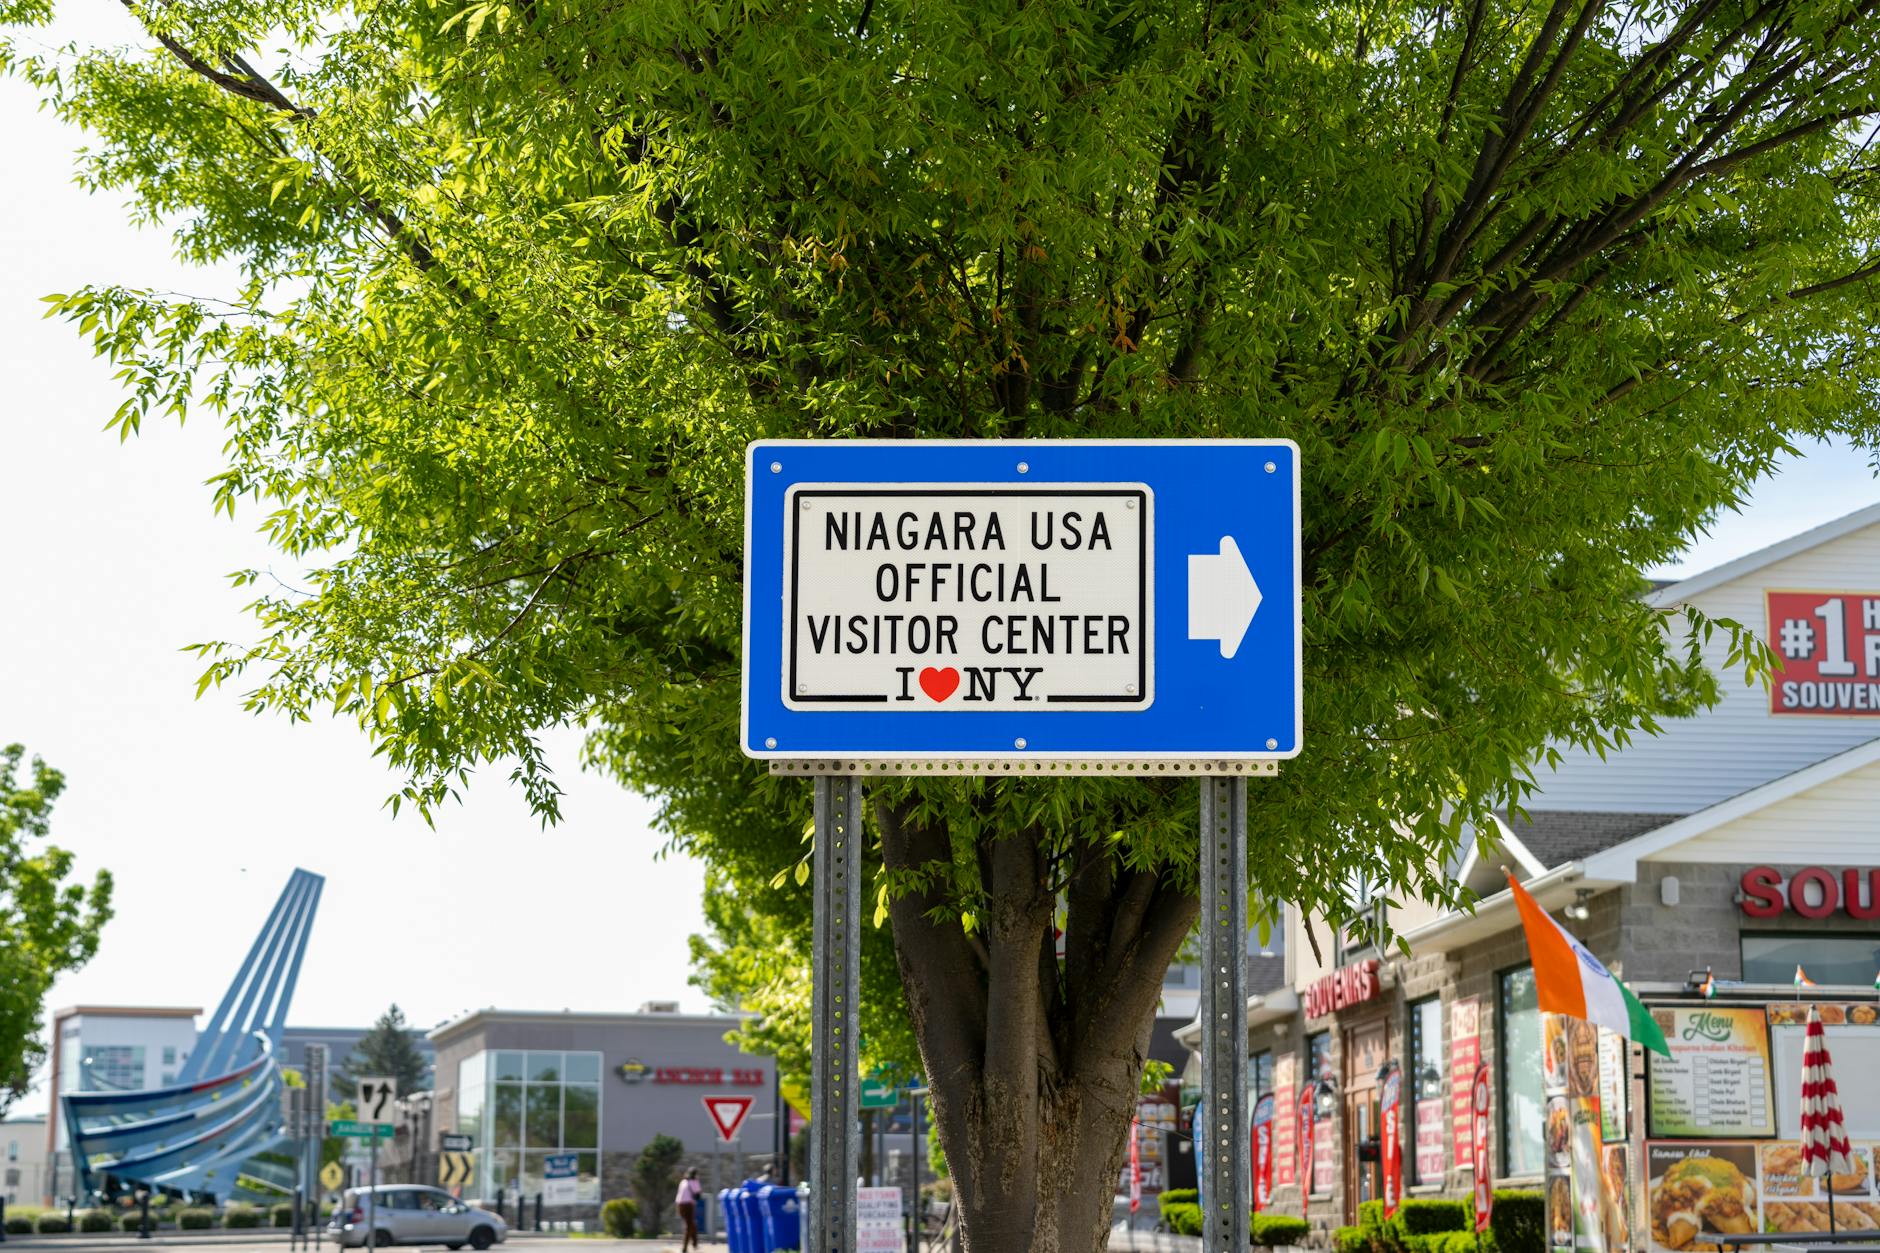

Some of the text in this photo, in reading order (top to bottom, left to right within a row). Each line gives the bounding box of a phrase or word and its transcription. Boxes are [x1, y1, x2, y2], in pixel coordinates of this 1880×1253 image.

[825, 511, 1112, 551] NIAGARA USA
[876, 563, 1061, 603] OFFICIAL
[807, 614, 1131, 655] VISITOR CENTER
[1780, 598, 1855, 675] #1
[895, 667, 915, 701] I
[1304, 959, 1379, 1019] SOUVENIRS
[1682, 1011, 1734, 1042] Menu
